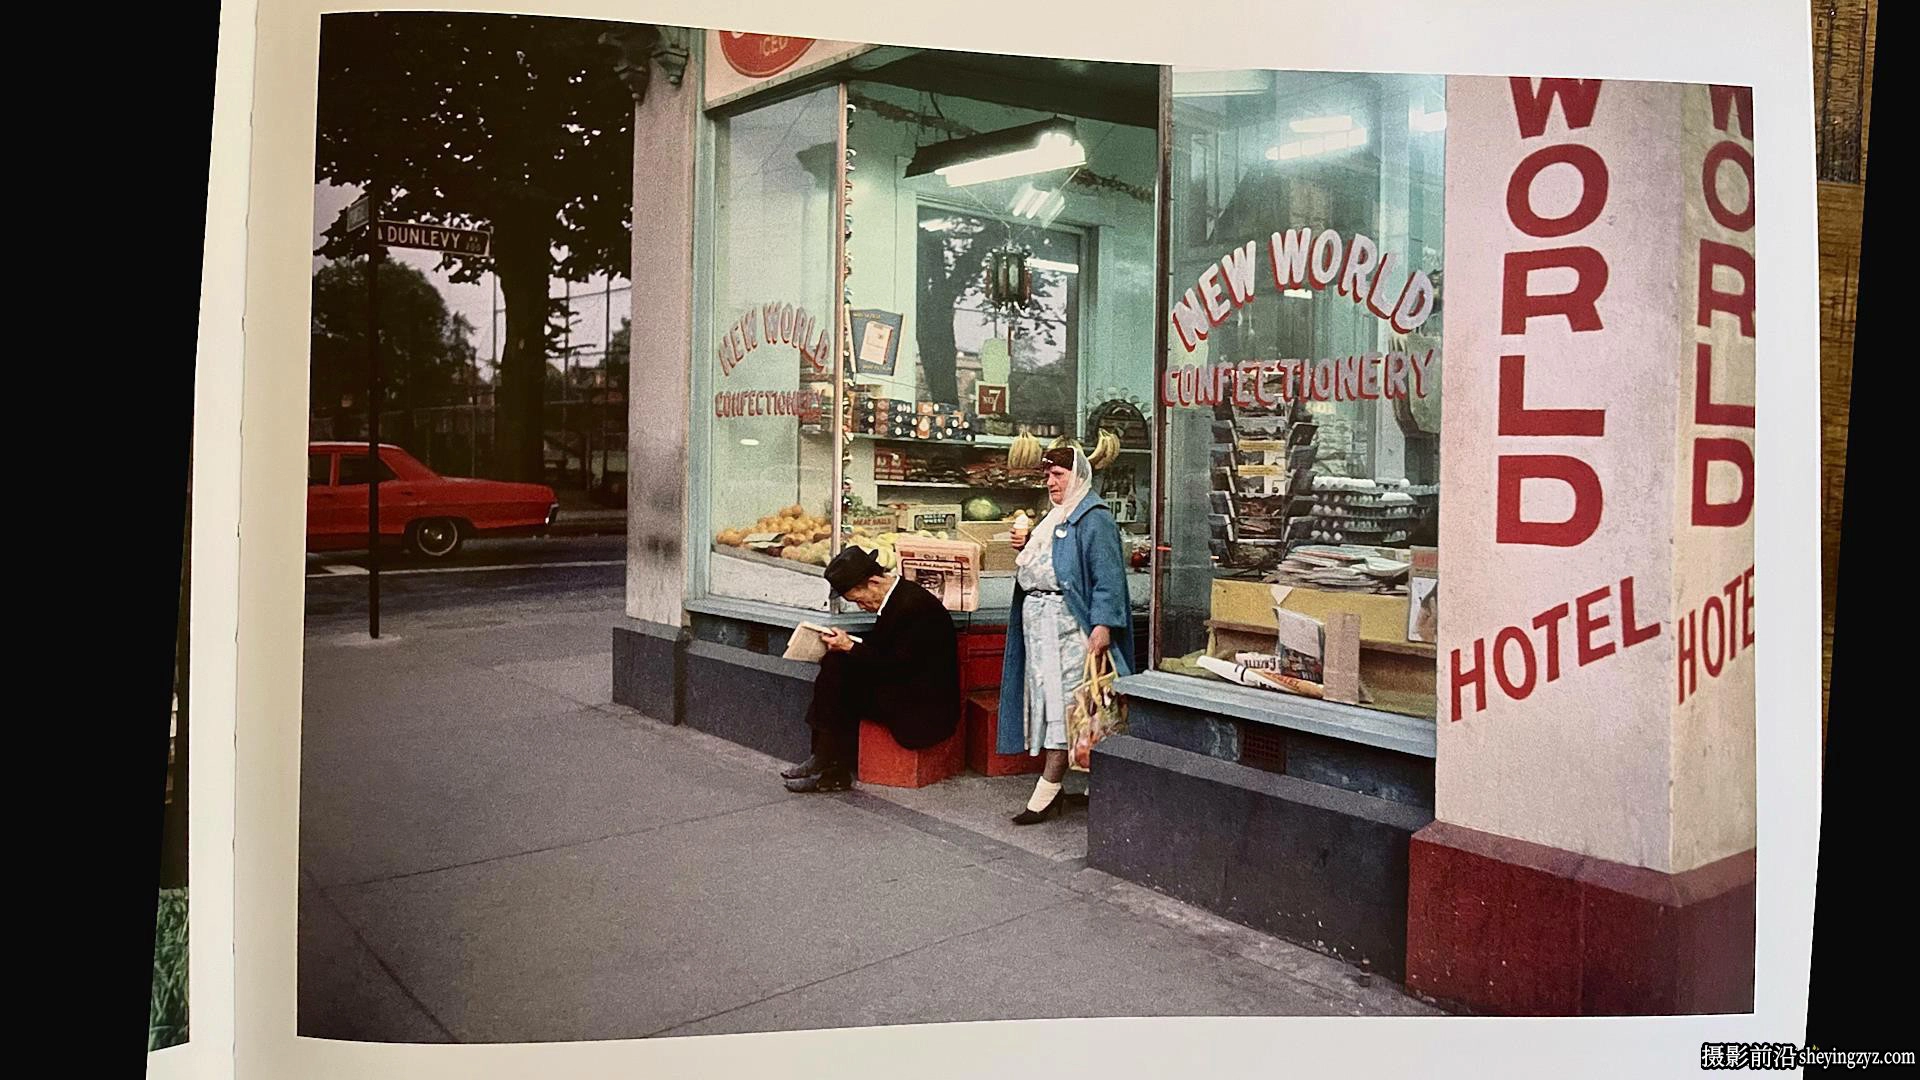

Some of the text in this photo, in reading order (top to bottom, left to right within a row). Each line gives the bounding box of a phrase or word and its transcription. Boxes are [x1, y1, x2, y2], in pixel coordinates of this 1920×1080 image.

[387, 225, 461, 249] DUNLEVY
[1172, 227, 1434, 352] NEW WORLD
[1496, 76, 1609, 547] WORLD
[718, 301, 831, 376] NEW WORLD
[715, 388, 826, 418] CONFECTIONERY
[989, 389, 1001, 412] 7
[1161, 348, 1434, 407] CONFECTIONERY
[1450, 575, 1662, 722] HOTEL
